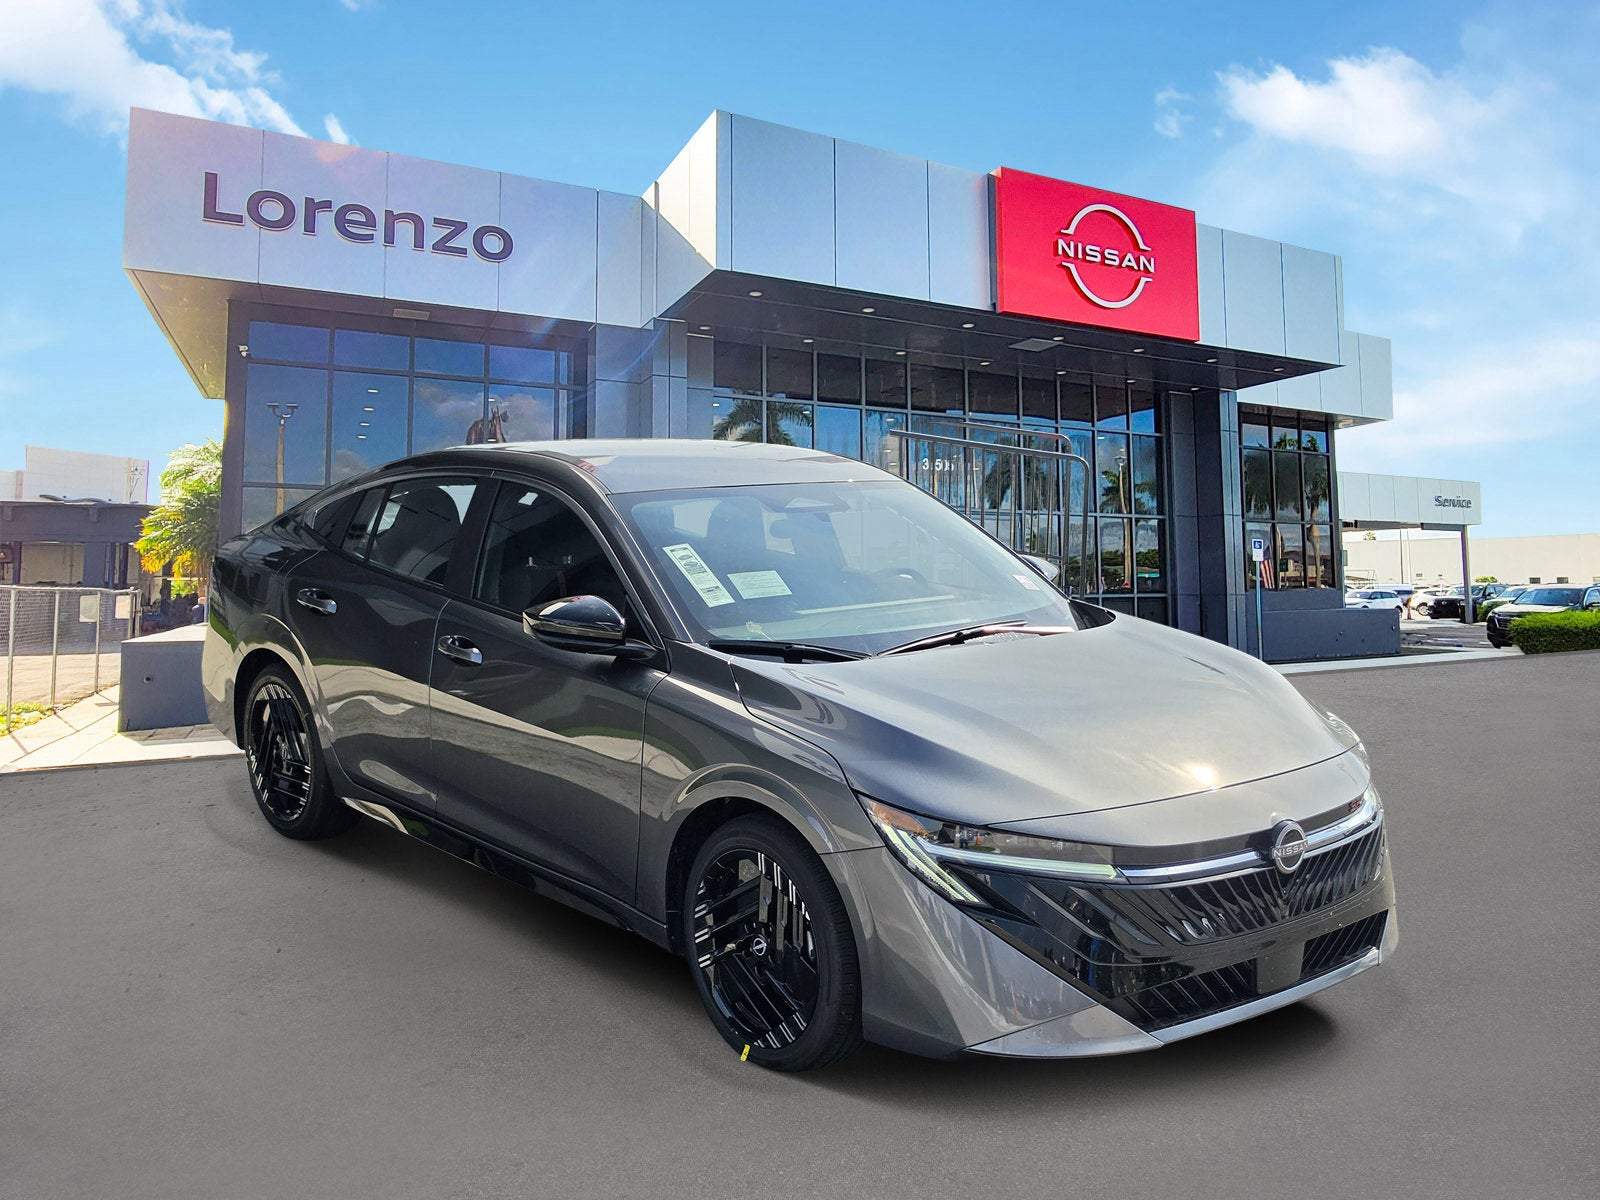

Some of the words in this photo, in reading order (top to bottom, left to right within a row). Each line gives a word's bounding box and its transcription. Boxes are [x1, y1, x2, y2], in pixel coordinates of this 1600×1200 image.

[202, 171, 514, 262] Lorenzo
[1056, 238, 1155, 273] NISSAN
[1434, 495, 1472, 509] Service
[1273, 842, 1308, 857] NISSAN
